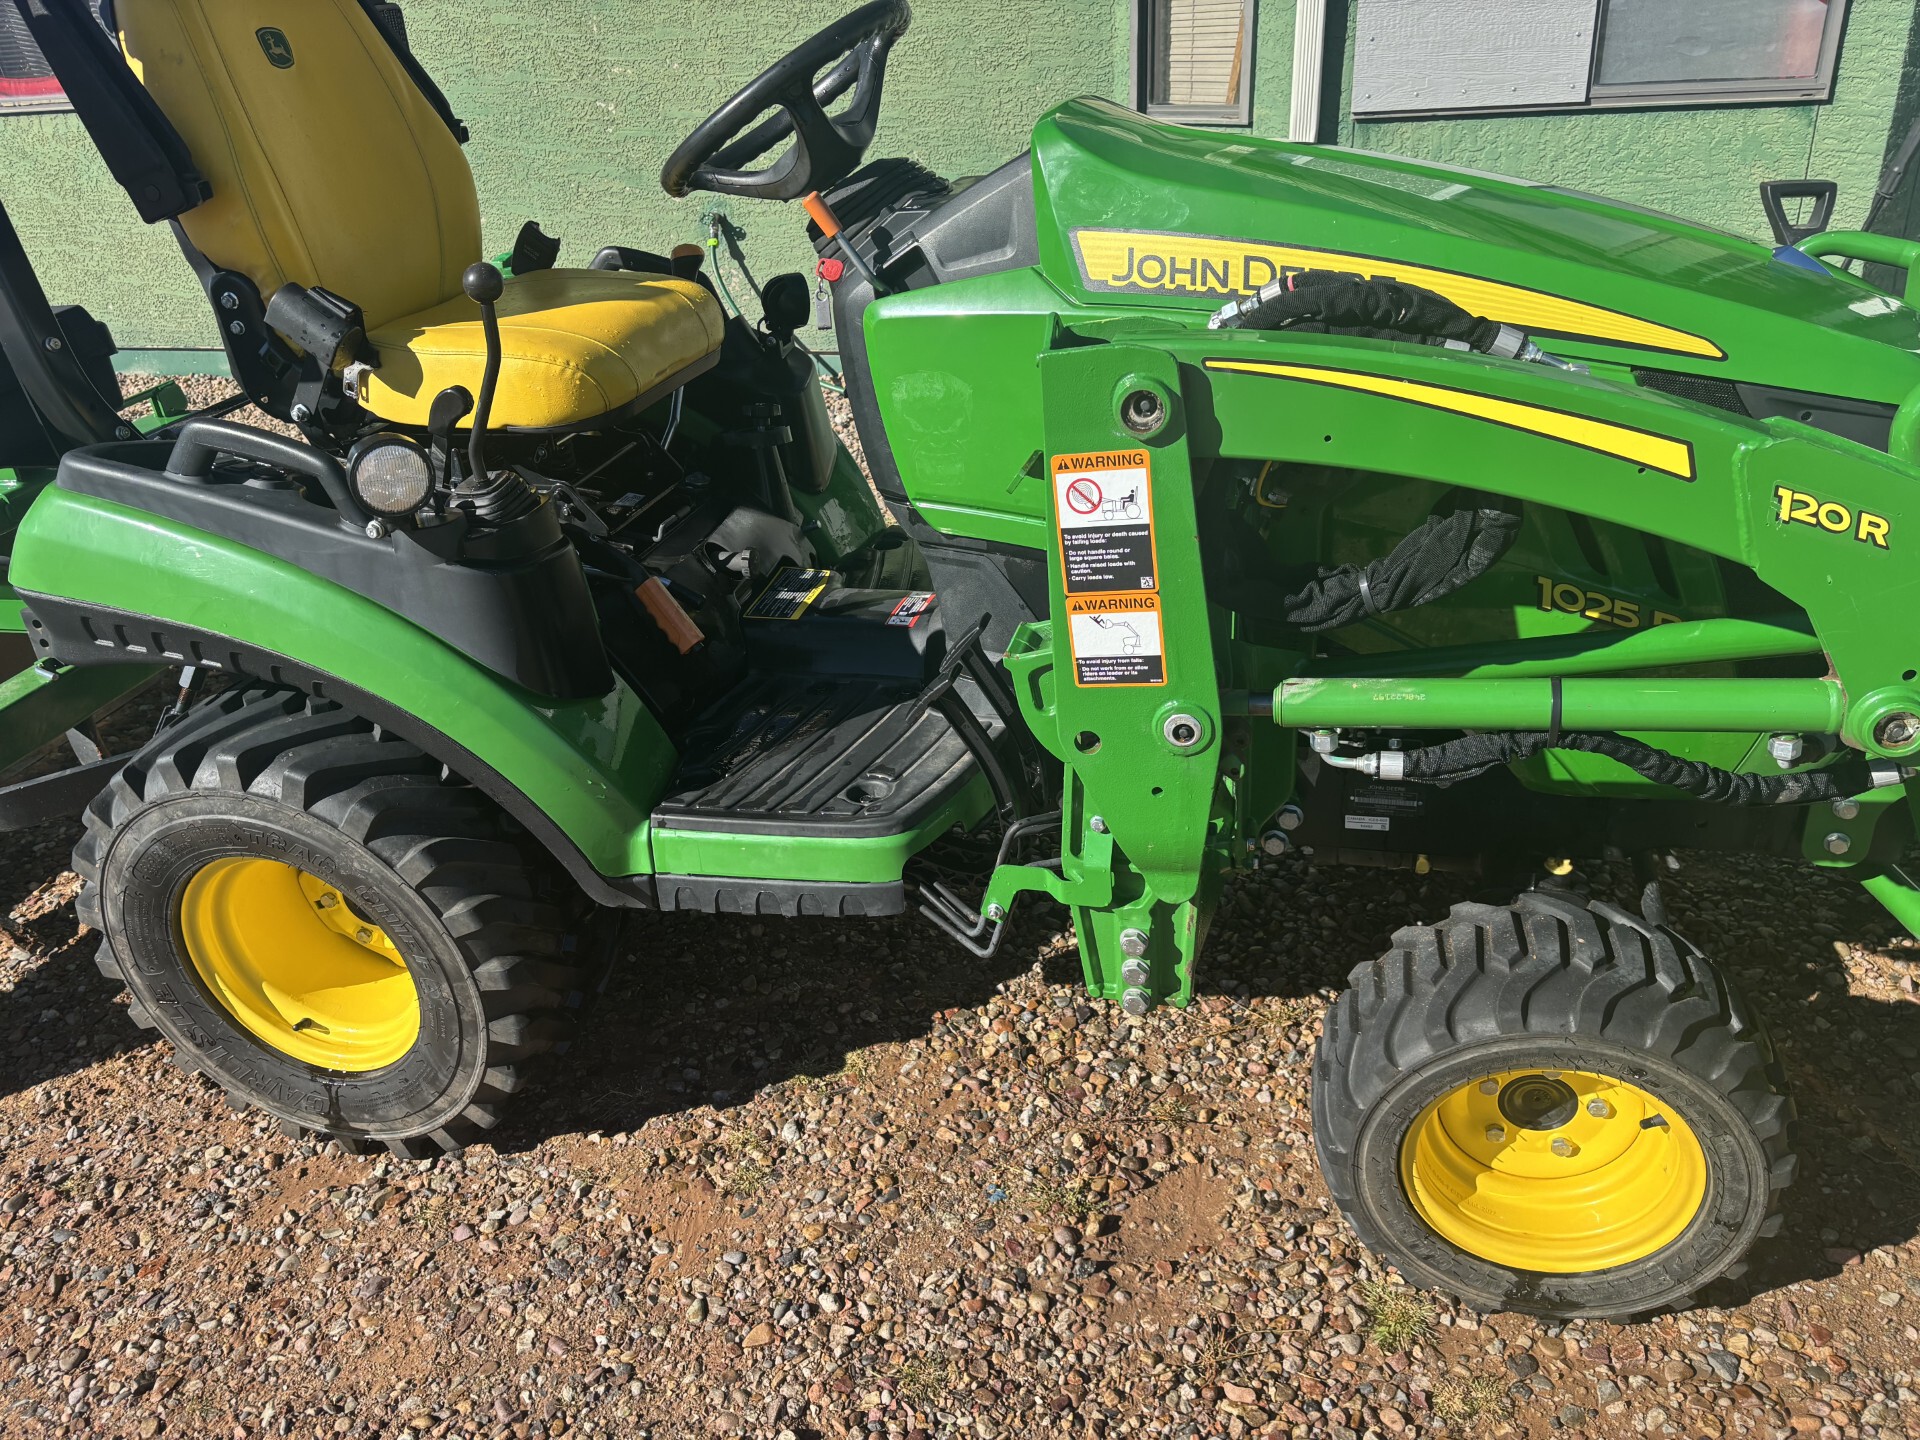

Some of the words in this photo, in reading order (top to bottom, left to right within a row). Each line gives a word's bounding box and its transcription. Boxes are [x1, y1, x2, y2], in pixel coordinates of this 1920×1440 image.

[1112, 247, 1229, 288] JOHN
[1071, 454, 1144, 469] WARNING
[1776, 486, 1851, 534] 120
[1854, 510, 1890, 550] R
[1084, 598, 1154, 610] WARNING
[1534, 576, 1640, 628] 1025
